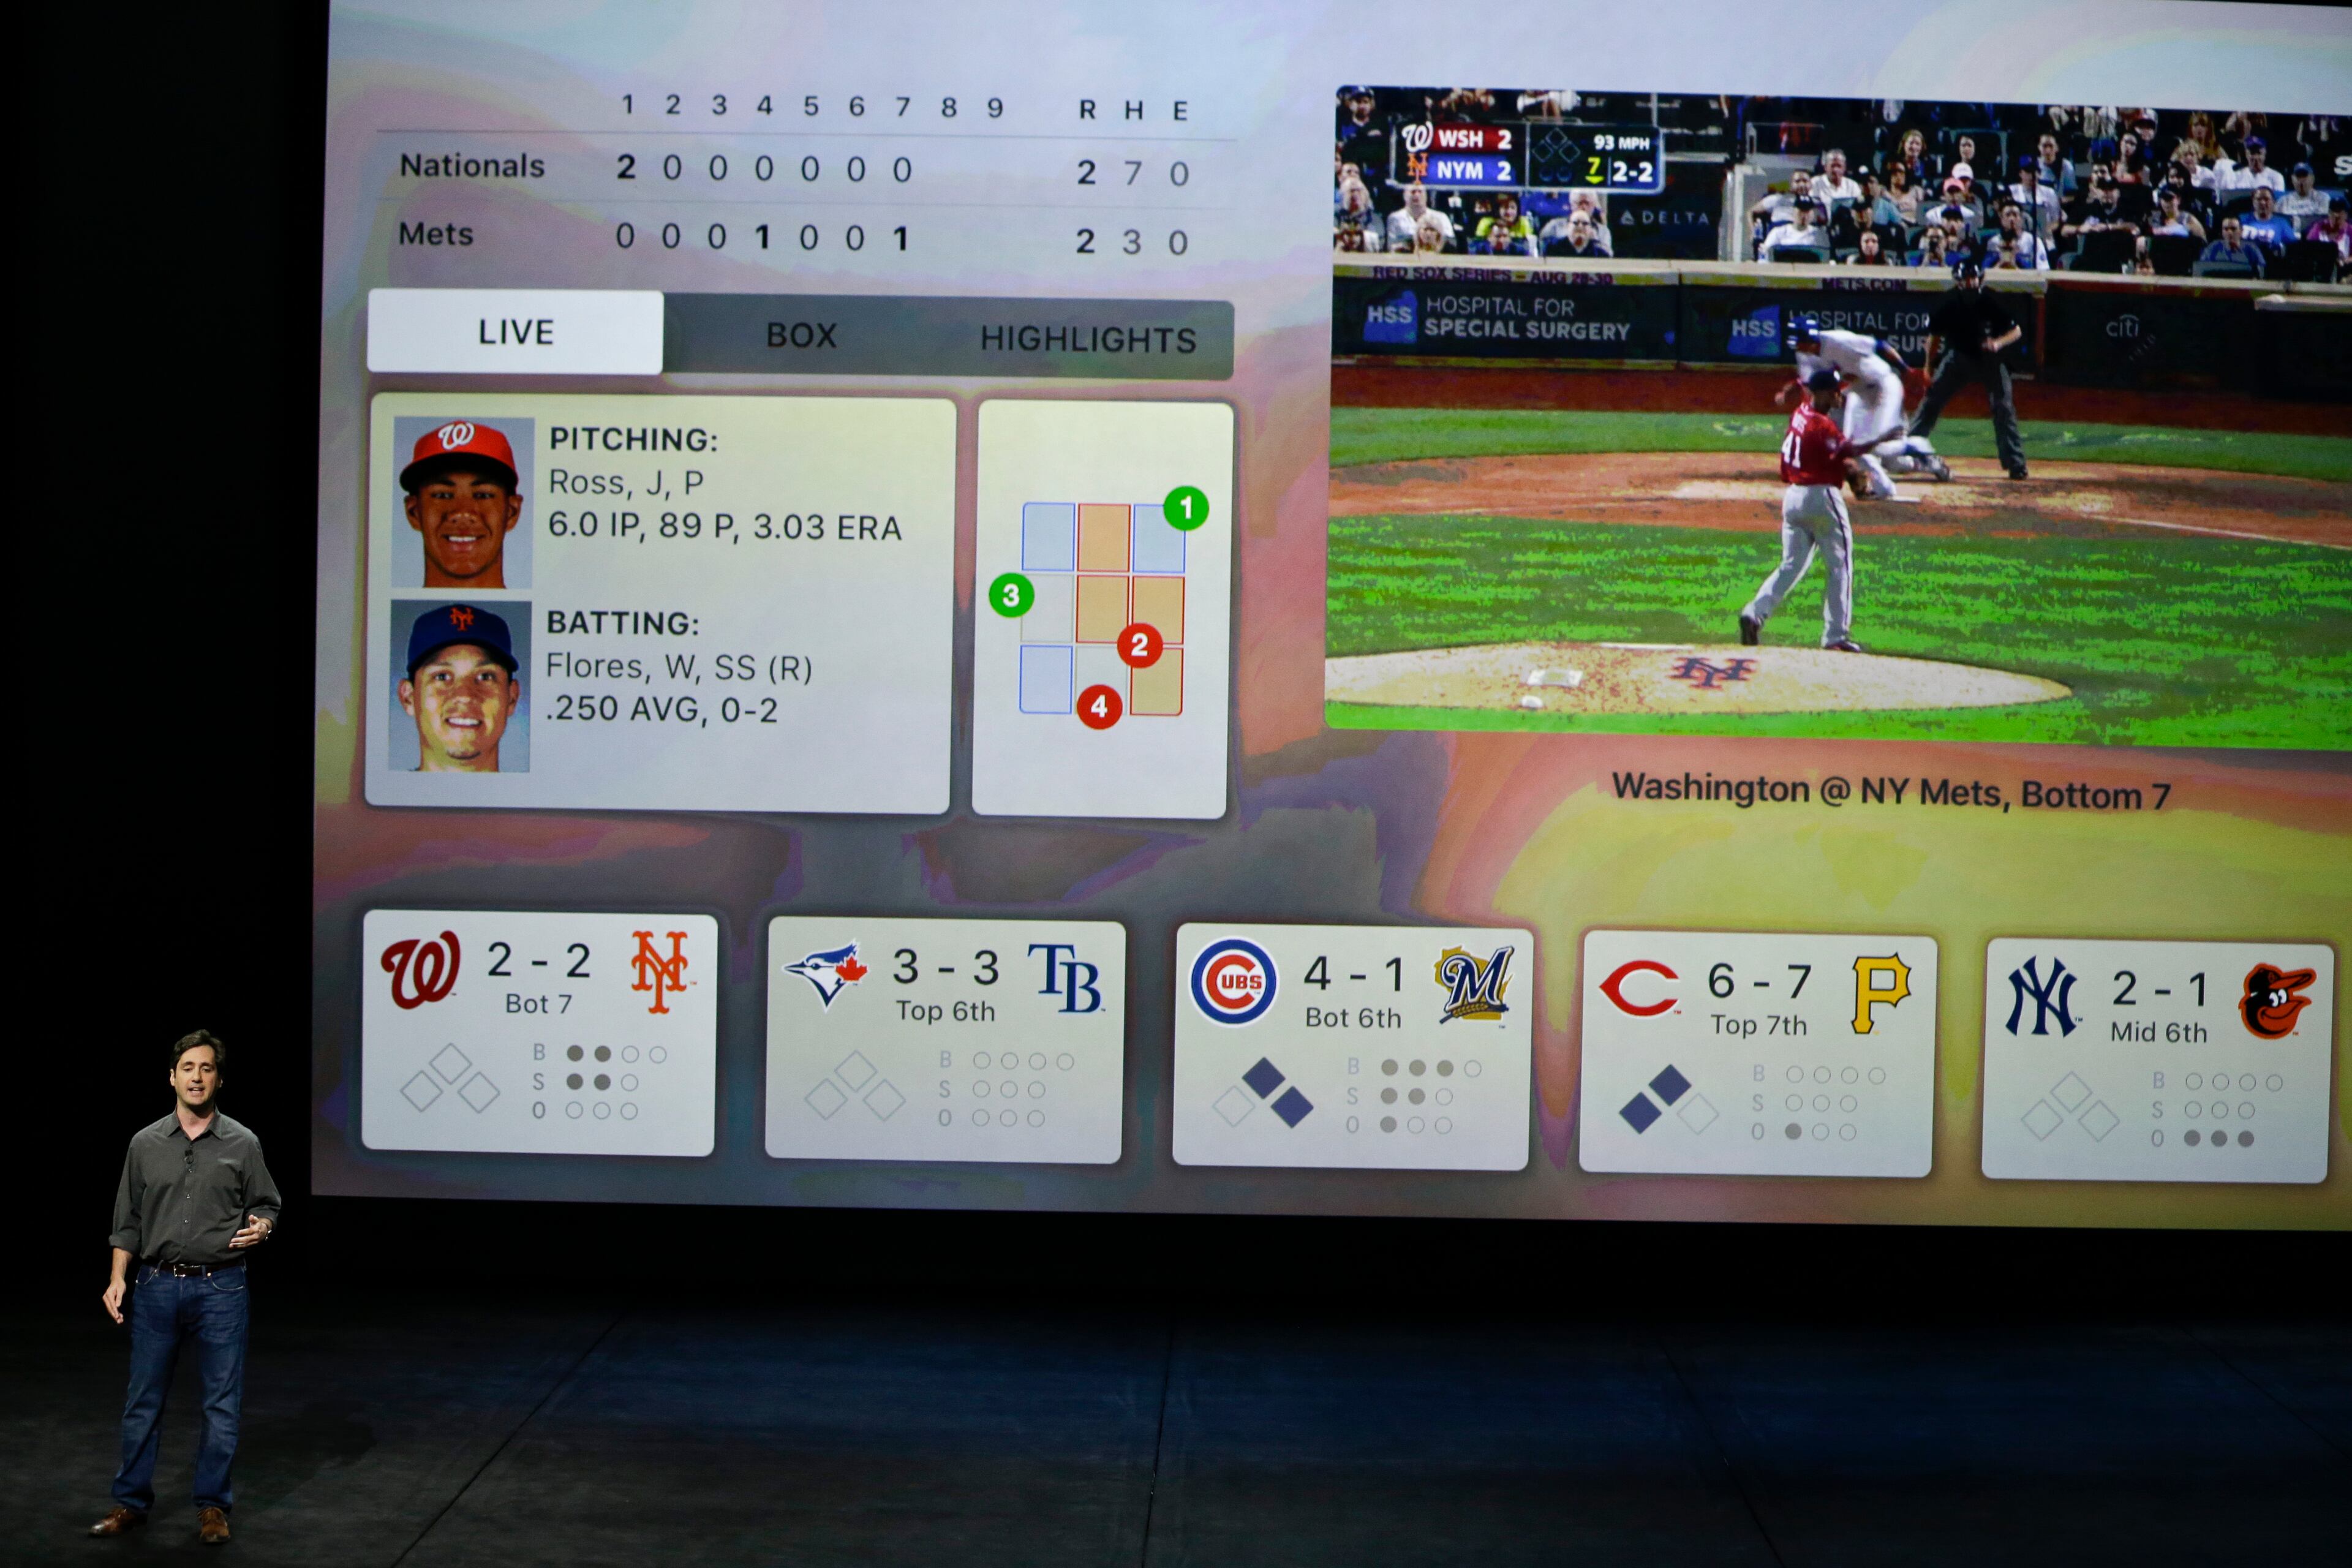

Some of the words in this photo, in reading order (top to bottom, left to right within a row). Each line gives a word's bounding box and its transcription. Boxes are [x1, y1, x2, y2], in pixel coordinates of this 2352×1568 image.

[624, 94, 631, 114] 1
[666, 94, 680, 115] 2
[713, 94, 726, 115] 3
[758, 96, 772, 115] 4
[805, 96, 818, 116] 5
[850, 96, 864, 116] 6
[897, 97, 910, 116] 7
[942, 97, 957, 118] 8
[988, 98, 1003, 118] 9
[1080, 100, 1095, 119] R
[1126, 101, 1142, 119] H
[1174, 101, 1186, 121] E
[1439, 130, 1483, 148] WSH
[1498, 130, 1512, 149] 2
[1594, 135, 1615, 150] 93
[1619, 137, 1650, 150] MPH
[401, 153, 544, 178] Nationals
[617, 154, 635, 179] 2
[663, 154, 681, 180] 0
[709, 155, 727, 181] 0
[755, 156, 773, 181] 0
[801, 156, 819, 181] 0
[848, 157, 865, 182] 0
[894, 157, 911, 183] 0
[1078, 160, 1095, 184] 2
[1125, 161, 1142, 185] 7
[1170, 162, 1189, 186] 0
[1438, 162, 1483, 179] NYM
[1498, 161, 1512, 181] 2
[1588, 157, 1601, 175] 7
[1613, 161, 1653, 183] 2-2
[1642, 211, 1709, 226] DELTA
[400, 222, 473, 246] Mets
[616, 223, 634, 249] 0
[662, 223, 680, 249] 0
[708, 224, 726, 249] 0
[756, 225, 767, 249] 1
[800, 225, 818, 250] 0
[846, 225, 864, 251] 0
[894, 227, 906, 251] 1
[1077, 229, 1095, 254] 2
[1123, 229, 1141, 255] 3
[1169, 230, 1188, 255] 0
[1413, 267, 1447, 280] SOX
[1368, 306, 1412, 323] HSS
[1427, 296, 1527, 317] HOSPITAL
[1534, 298, 1575, 317] FOR
[480, 319, 552, 344] LIVE
[767, 322, 836, 348] BOX
[982, 325, 1196, 353] HIGHLIGHTS
[1425, 318, 1520, 339] SPECIAL
[1526, 322, 1631, 341] SURGERY
[1732, 319, 1775, 337] HSS
[551, 427, 716, 451] PITCHING:
[551, 469, 631, 500] Ross,
[647, 470, 669, 500] J,
[686, 471, 703, 494] P
[1181, 496, 1192, 519] 1
[549, 511, 597, 537] 6.0
[612, 513, 644, 543] IP,
[660, 513, 701, 538] 89
[715, 514, 738, 545] P,
[755, 514, 824, 540] 3.03
[839, 516, 902, 540] ERA
[1003, 584, 1020, 608] 3
[548, 611, 698, 635] BATTING:
[1131, 633, 1148, 656] 2
[548, 652, 650, 684] Flores,
[666, 655, 700, 685] W,
[715, 654, 755, 680] SS
[770, 656, 811, 685] (R)
[548, 695, 617, 721] .250
[630, 696, 706, 728] AVG,
[722, 697, 777, 723] 0-2
[1091, 695, 1107, 718] 4
[1613, 772, 1809, 809] Washington
[1820, 776, 1850, 807] @
[1862, 777, 1909, 804] NY
[1921, 778, 2010, 813] Mets,
[2022, 781, 2141, 809] Bottom
[2152, 783, 2171, 810] 7
[488, 942, 511, 976] 2
[567, 943, 589, 978] 2
[894, 949, 918, 984] 3
[974, 950, 998, 986] 3
[1304, 956, 1330, 990] 4
[1386, 957, 1401, 991] 1
[1709, 963, 1734, 998] 6
[1789, 965, 1811, 998] 7
[2114, 971, 2136, 1005] 2
[2190, 973, 2204, 1006] 1
[507, 993, 548, 1014] Bot
[559, 995, 571, 1014] 7
[896, 1000, 942, 1025] Top
[953, 1001, 994, 1021] 6th
[1306, 1008, 1348, 1027] Bot
[1359, 1008, 1401, 1028] 6th
[1711, 1014, 1757, 1039] Top
[1768, 1015, 1806, 1035] 7th
[2112, 1021, 2155, 1042] Mid
[2166, 1022, 2207, 1042] 6th
[533, 1043, 545, 1060] B
[940, 1050, 951, 1068] B
[1348, 1057, 1359, 1075] B
[1754, 1065, 1765, 1082] B
[533, 1072, 544, 1090] S
[940, 1080, 950, 1098] S
[2154, 1071, 2165, 1089] B
[1347, 1087, 1358, 1105] S
[1752, 1094, 1763, 1112] S
[2152, 1101, 2163, 1119] S
